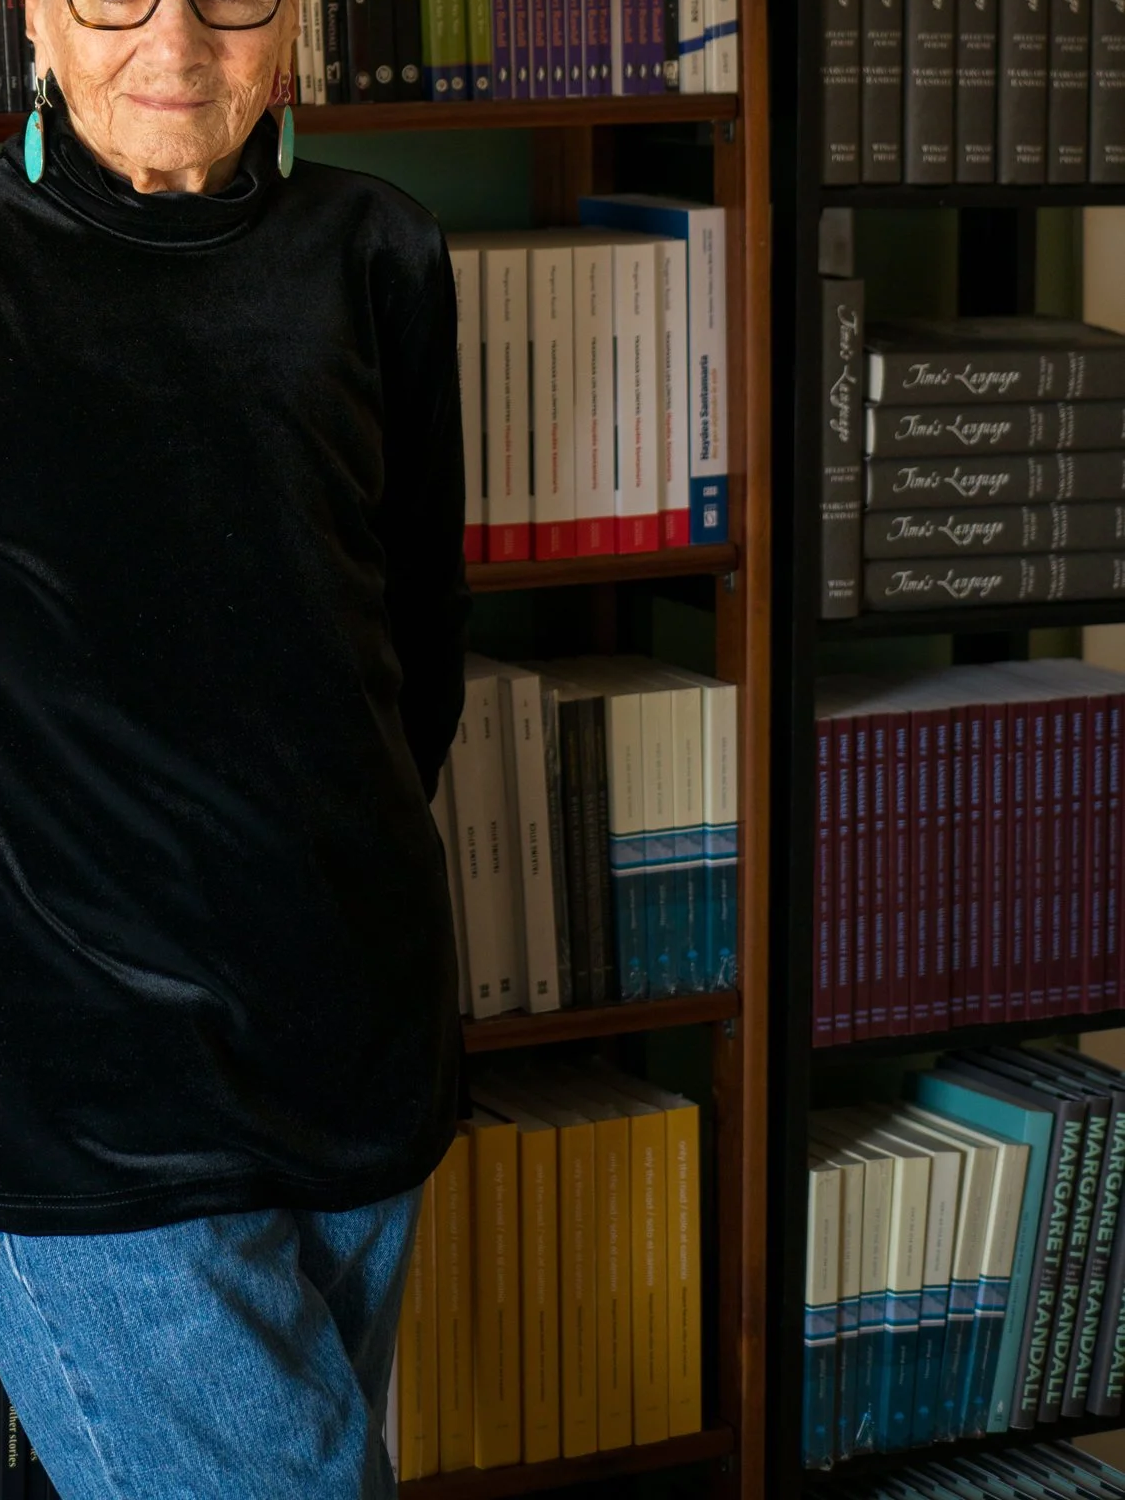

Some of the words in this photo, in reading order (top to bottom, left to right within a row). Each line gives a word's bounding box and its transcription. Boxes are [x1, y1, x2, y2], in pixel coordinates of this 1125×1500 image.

[1044, 1121, 1083, 1268] MARGARET
[1069, 1116, 1107, 1264] MARGARET
[1022, 1289, 1054, 1411] RANDALL
[1046, 1284, 1079, 1405] RANDALL
[1072, 1279, 1106, 1399] RANDALL
